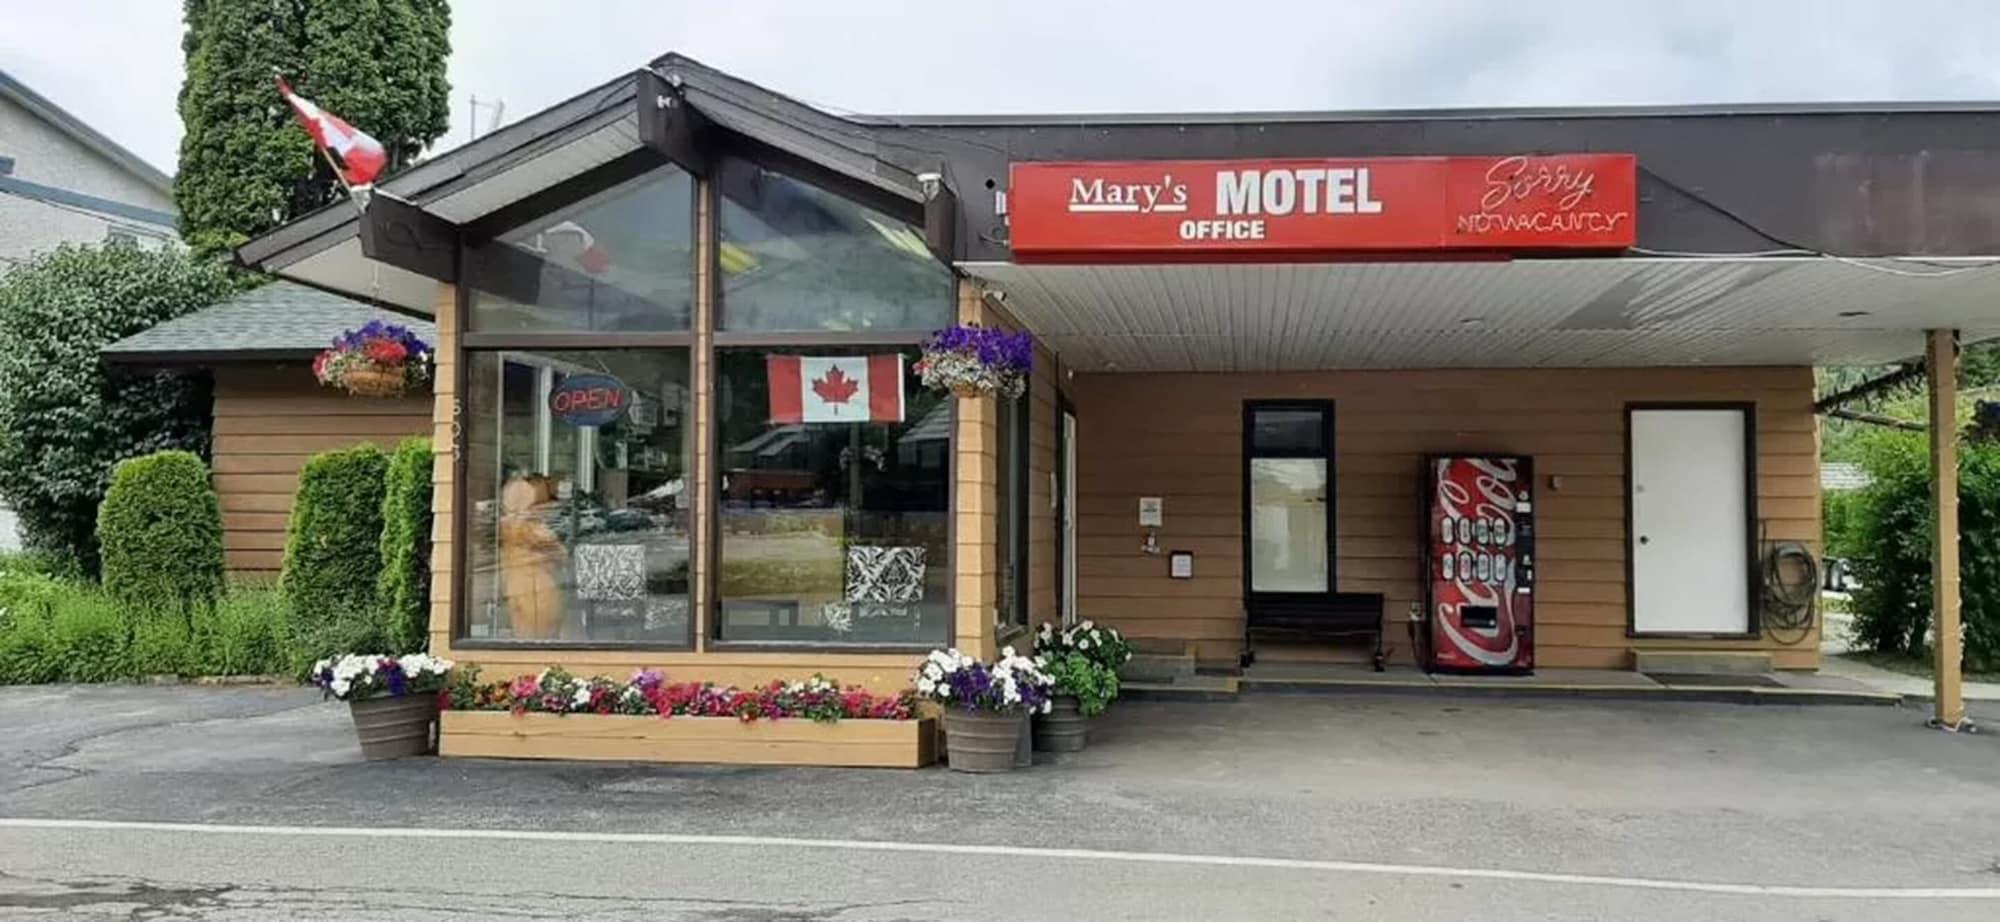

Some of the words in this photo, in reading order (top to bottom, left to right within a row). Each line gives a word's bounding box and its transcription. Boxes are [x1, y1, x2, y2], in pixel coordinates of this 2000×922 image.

[1068, 174, 1188, 213] Mary's
[1216, 168, 1382, 215] MOTEL
[1481, 156, 1595, 210] Sorry
[1179, 219, 1265, 240] OFFICE
[553, 389, 622, 413] OPEN
